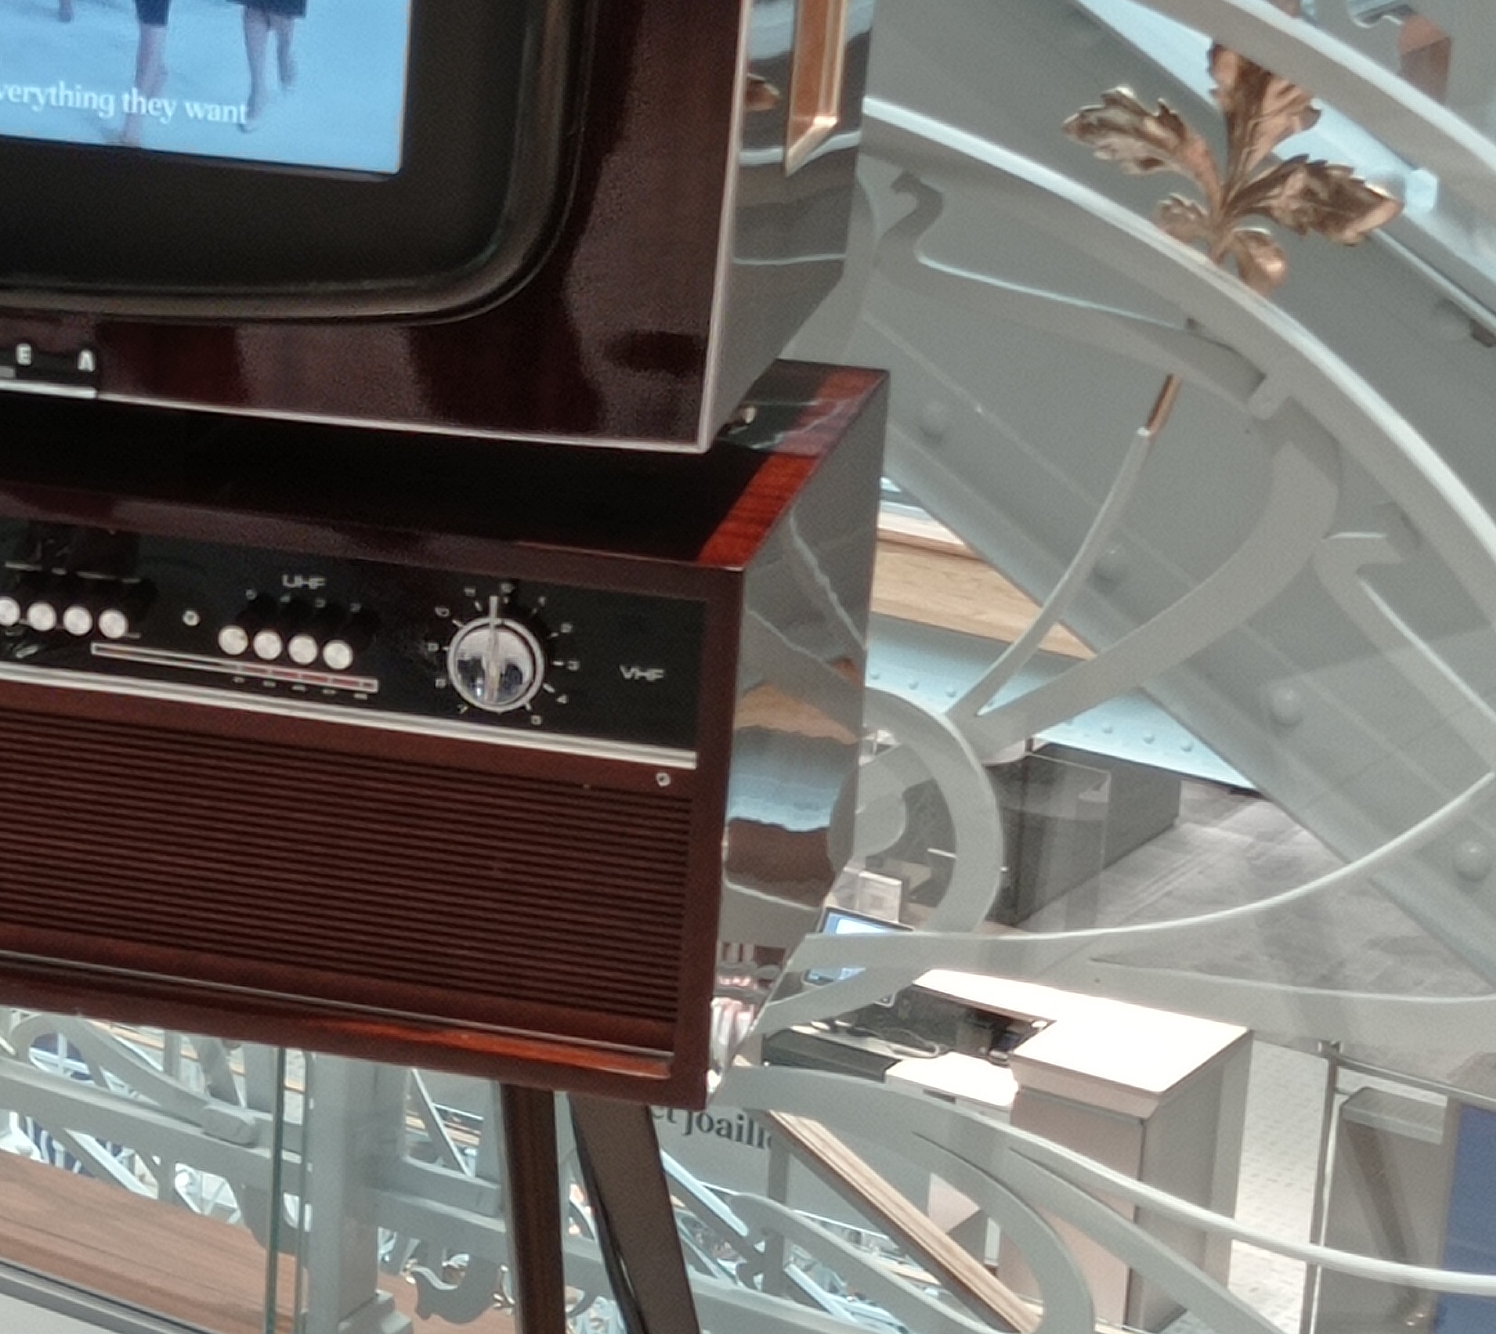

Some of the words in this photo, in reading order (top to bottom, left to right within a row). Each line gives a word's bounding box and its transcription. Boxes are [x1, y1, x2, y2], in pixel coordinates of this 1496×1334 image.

[121, 87, 177, 124] they
[184, 100, 248, 124] want
[281, 574, 326, 590] UHF
[619, 664, 665, 681] VHF
